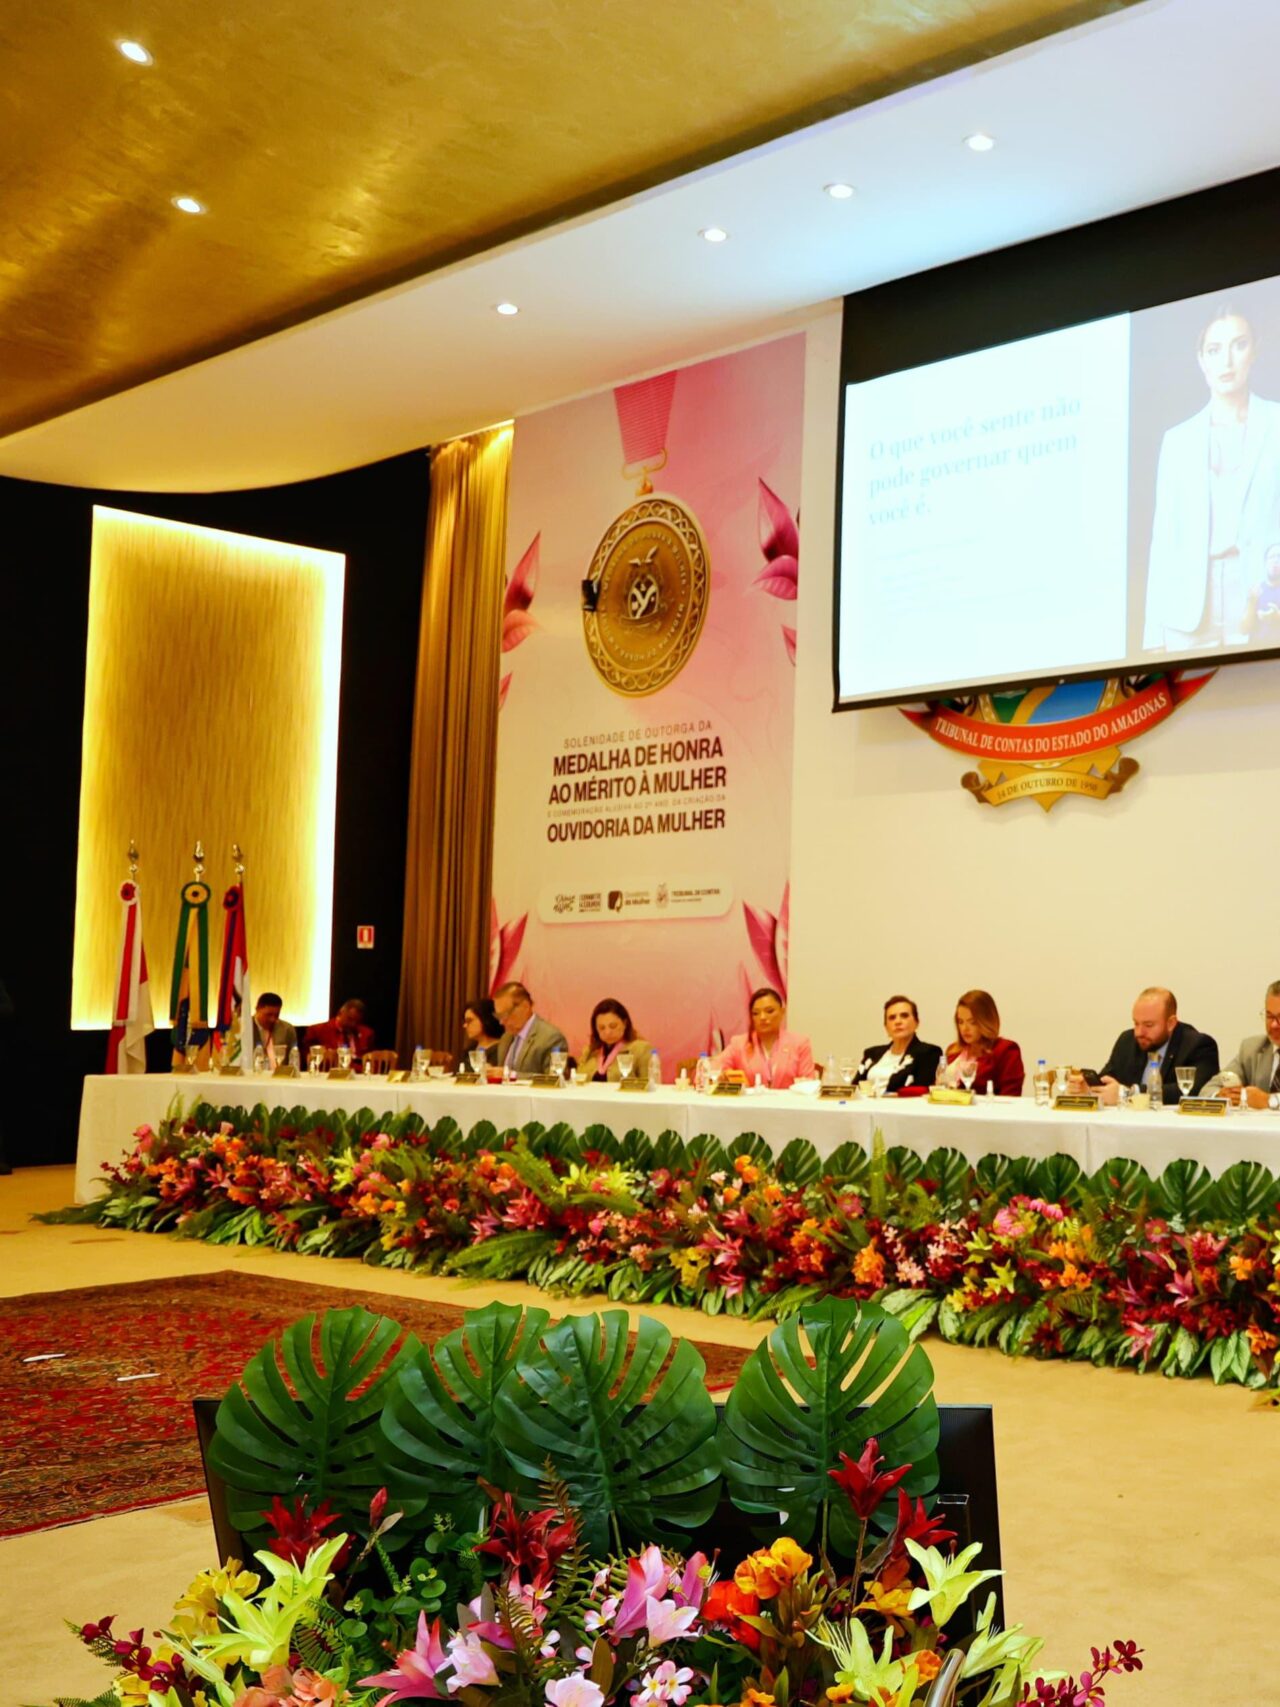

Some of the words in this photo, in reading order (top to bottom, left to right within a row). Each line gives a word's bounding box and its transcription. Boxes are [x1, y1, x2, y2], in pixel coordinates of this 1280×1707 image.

[869, 441, 885, 461] O
[890, 436, 925, 462] que
[928, 416, 974, 448] você
[979, 408, 1036, 433] sente
[1040, 394, 1081, 422] não
[869, 465, 915, 500] pode
[920, 448, 1012, 488] governar
[1017, 433, 1078, 464] quem
[869, 497, 910, 525] você
[563, 731, 625, 750] SOLENIDADE
[629, 729, 641, 741] DE
[644, 722, 695, 738] OUTORGA
[698, 720, 712, 731] DA
[935, 716, 979, 747] TRIBUNAL
[980, 734, 994, 750] DE
[994, 737, 1034, 753] CONTAS
[1035, 737, 1050, 753] DO
[1052, 729, 1091, 751] ESTADO
[1093, 723, 1109, 742] DO
[1111, 692, 1167, 737] AMAZONAS
[553, 748, 632, 777] MEDALHA
[635, 744, 658, 767] DE
[660, 736, 724, 763] HONRA
[549, 783, 571, 805] AO
[574, 776, 636, 803] MÉRITO
[639, 770, 650, 795] À
[653, 766, 727, 793] MULHER
[1007, 784, 1019, 796] DE
[1021, 777, 1063, 791] OUTUBRO
[1066, 778, 1078, 788] DE
[547, 817, 631, 843] OUVIDORIA
[633, 815, 655, 836] DA
[657, 808, 726, 834] MULHER
